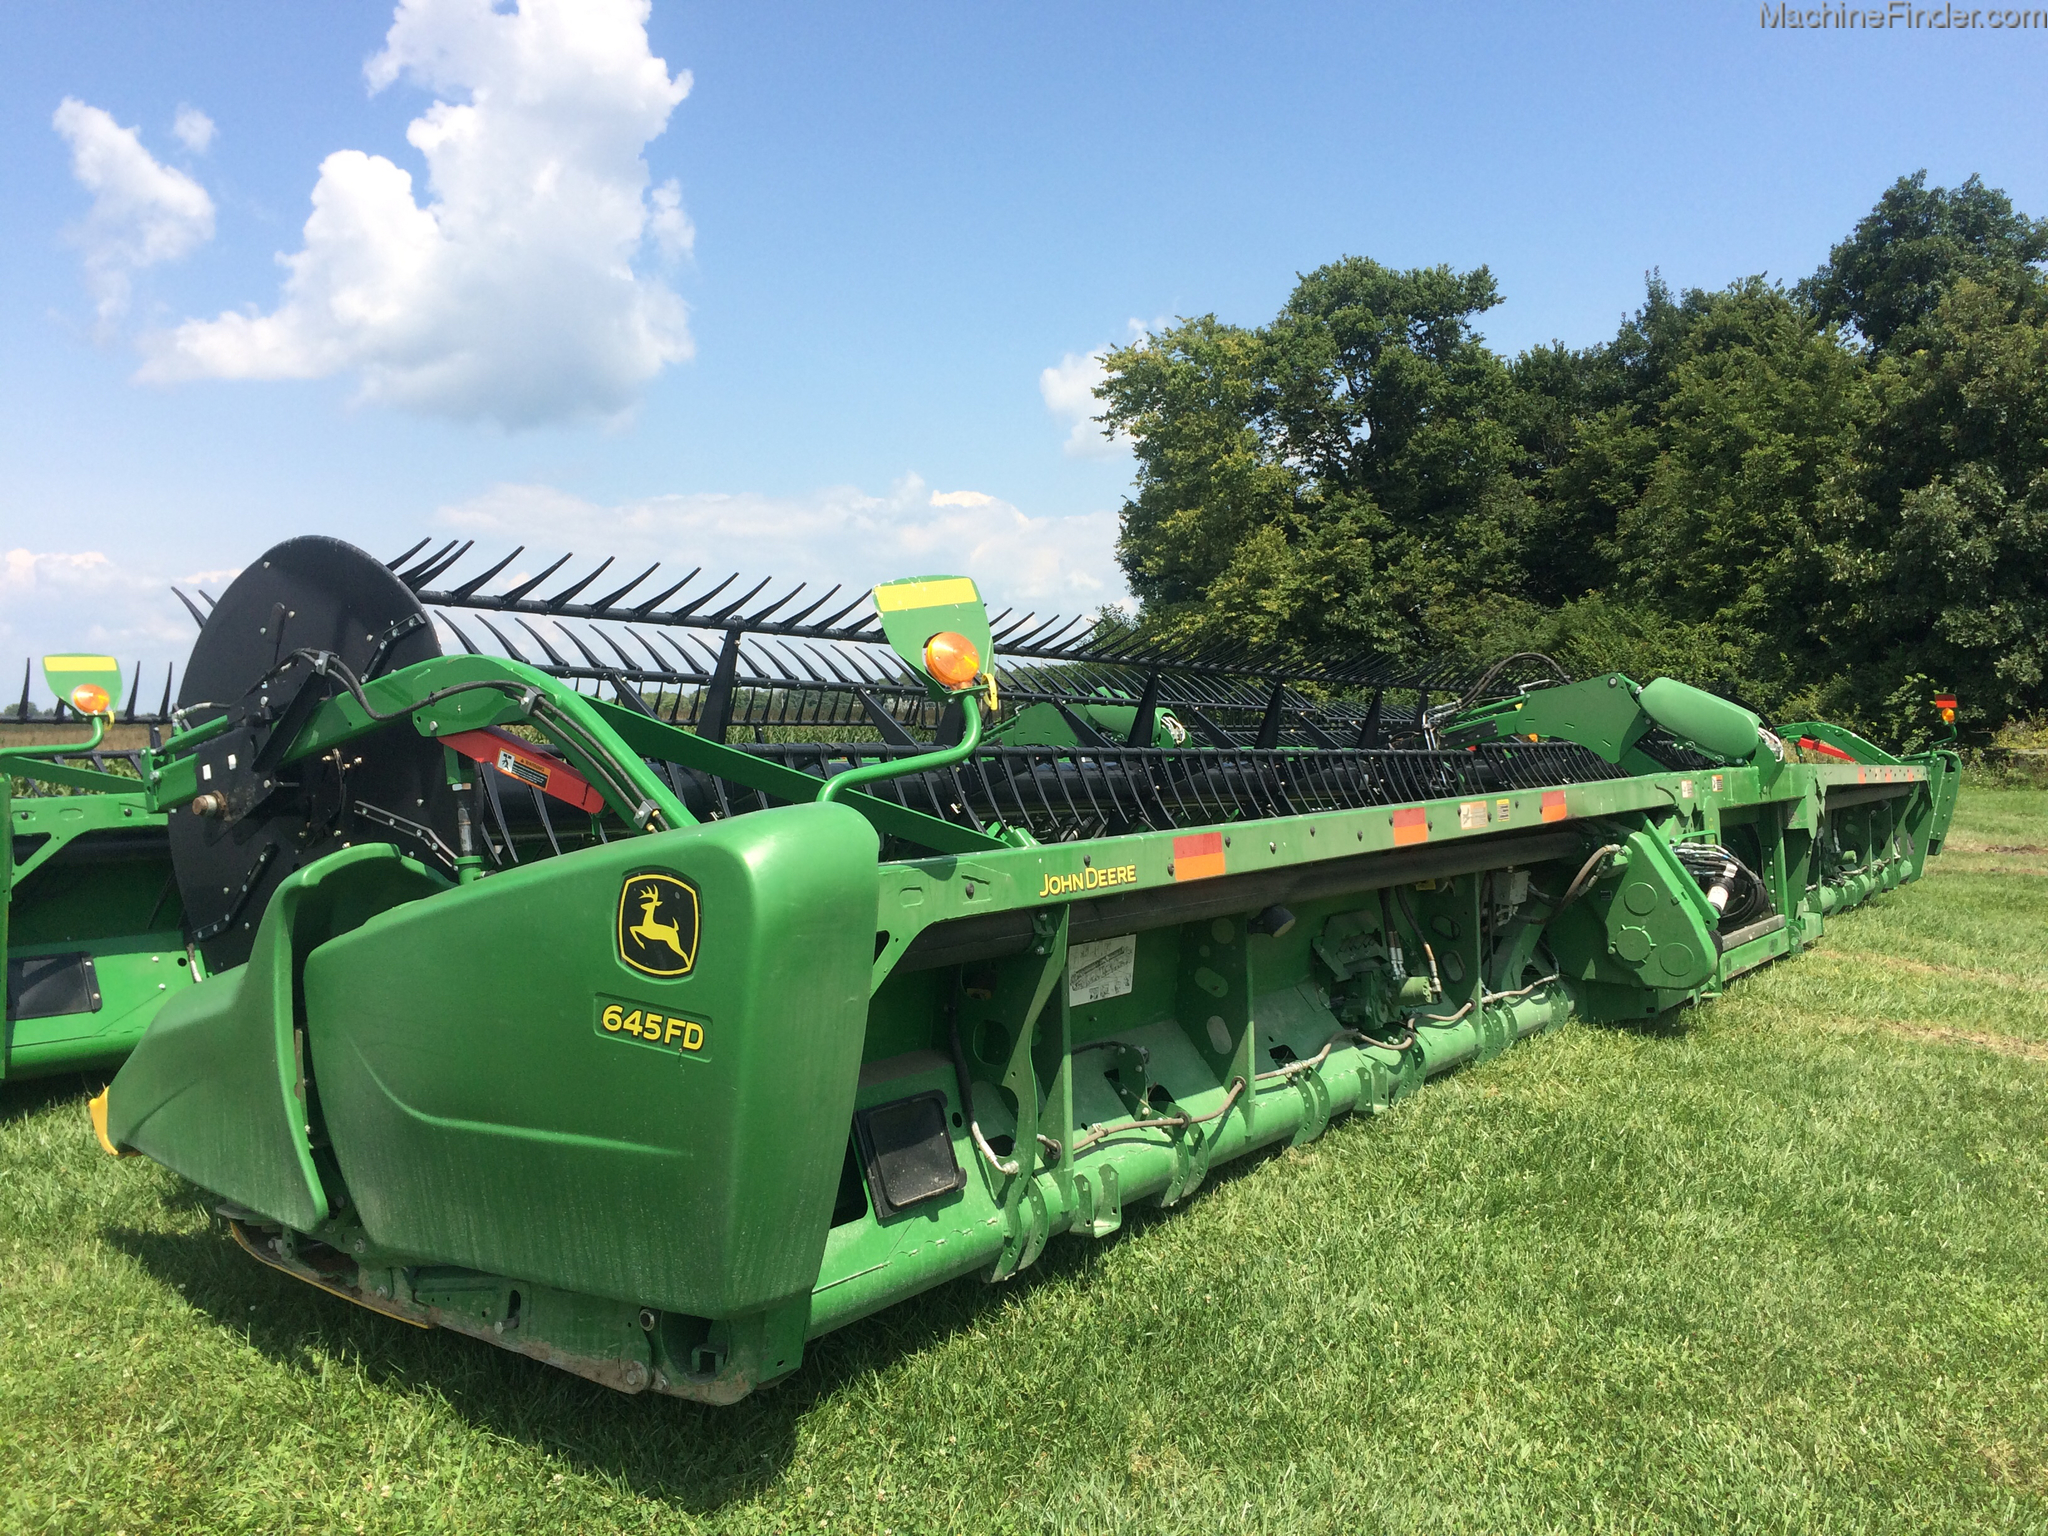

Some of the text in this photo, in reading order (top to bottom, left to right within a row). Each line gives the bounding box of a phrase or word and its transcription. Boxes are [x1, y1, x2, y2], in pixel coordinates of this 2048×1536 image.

[1039, 864, 1137, 897] JOHN DEERE
[602, 1004, 705, 1051] 645FD
